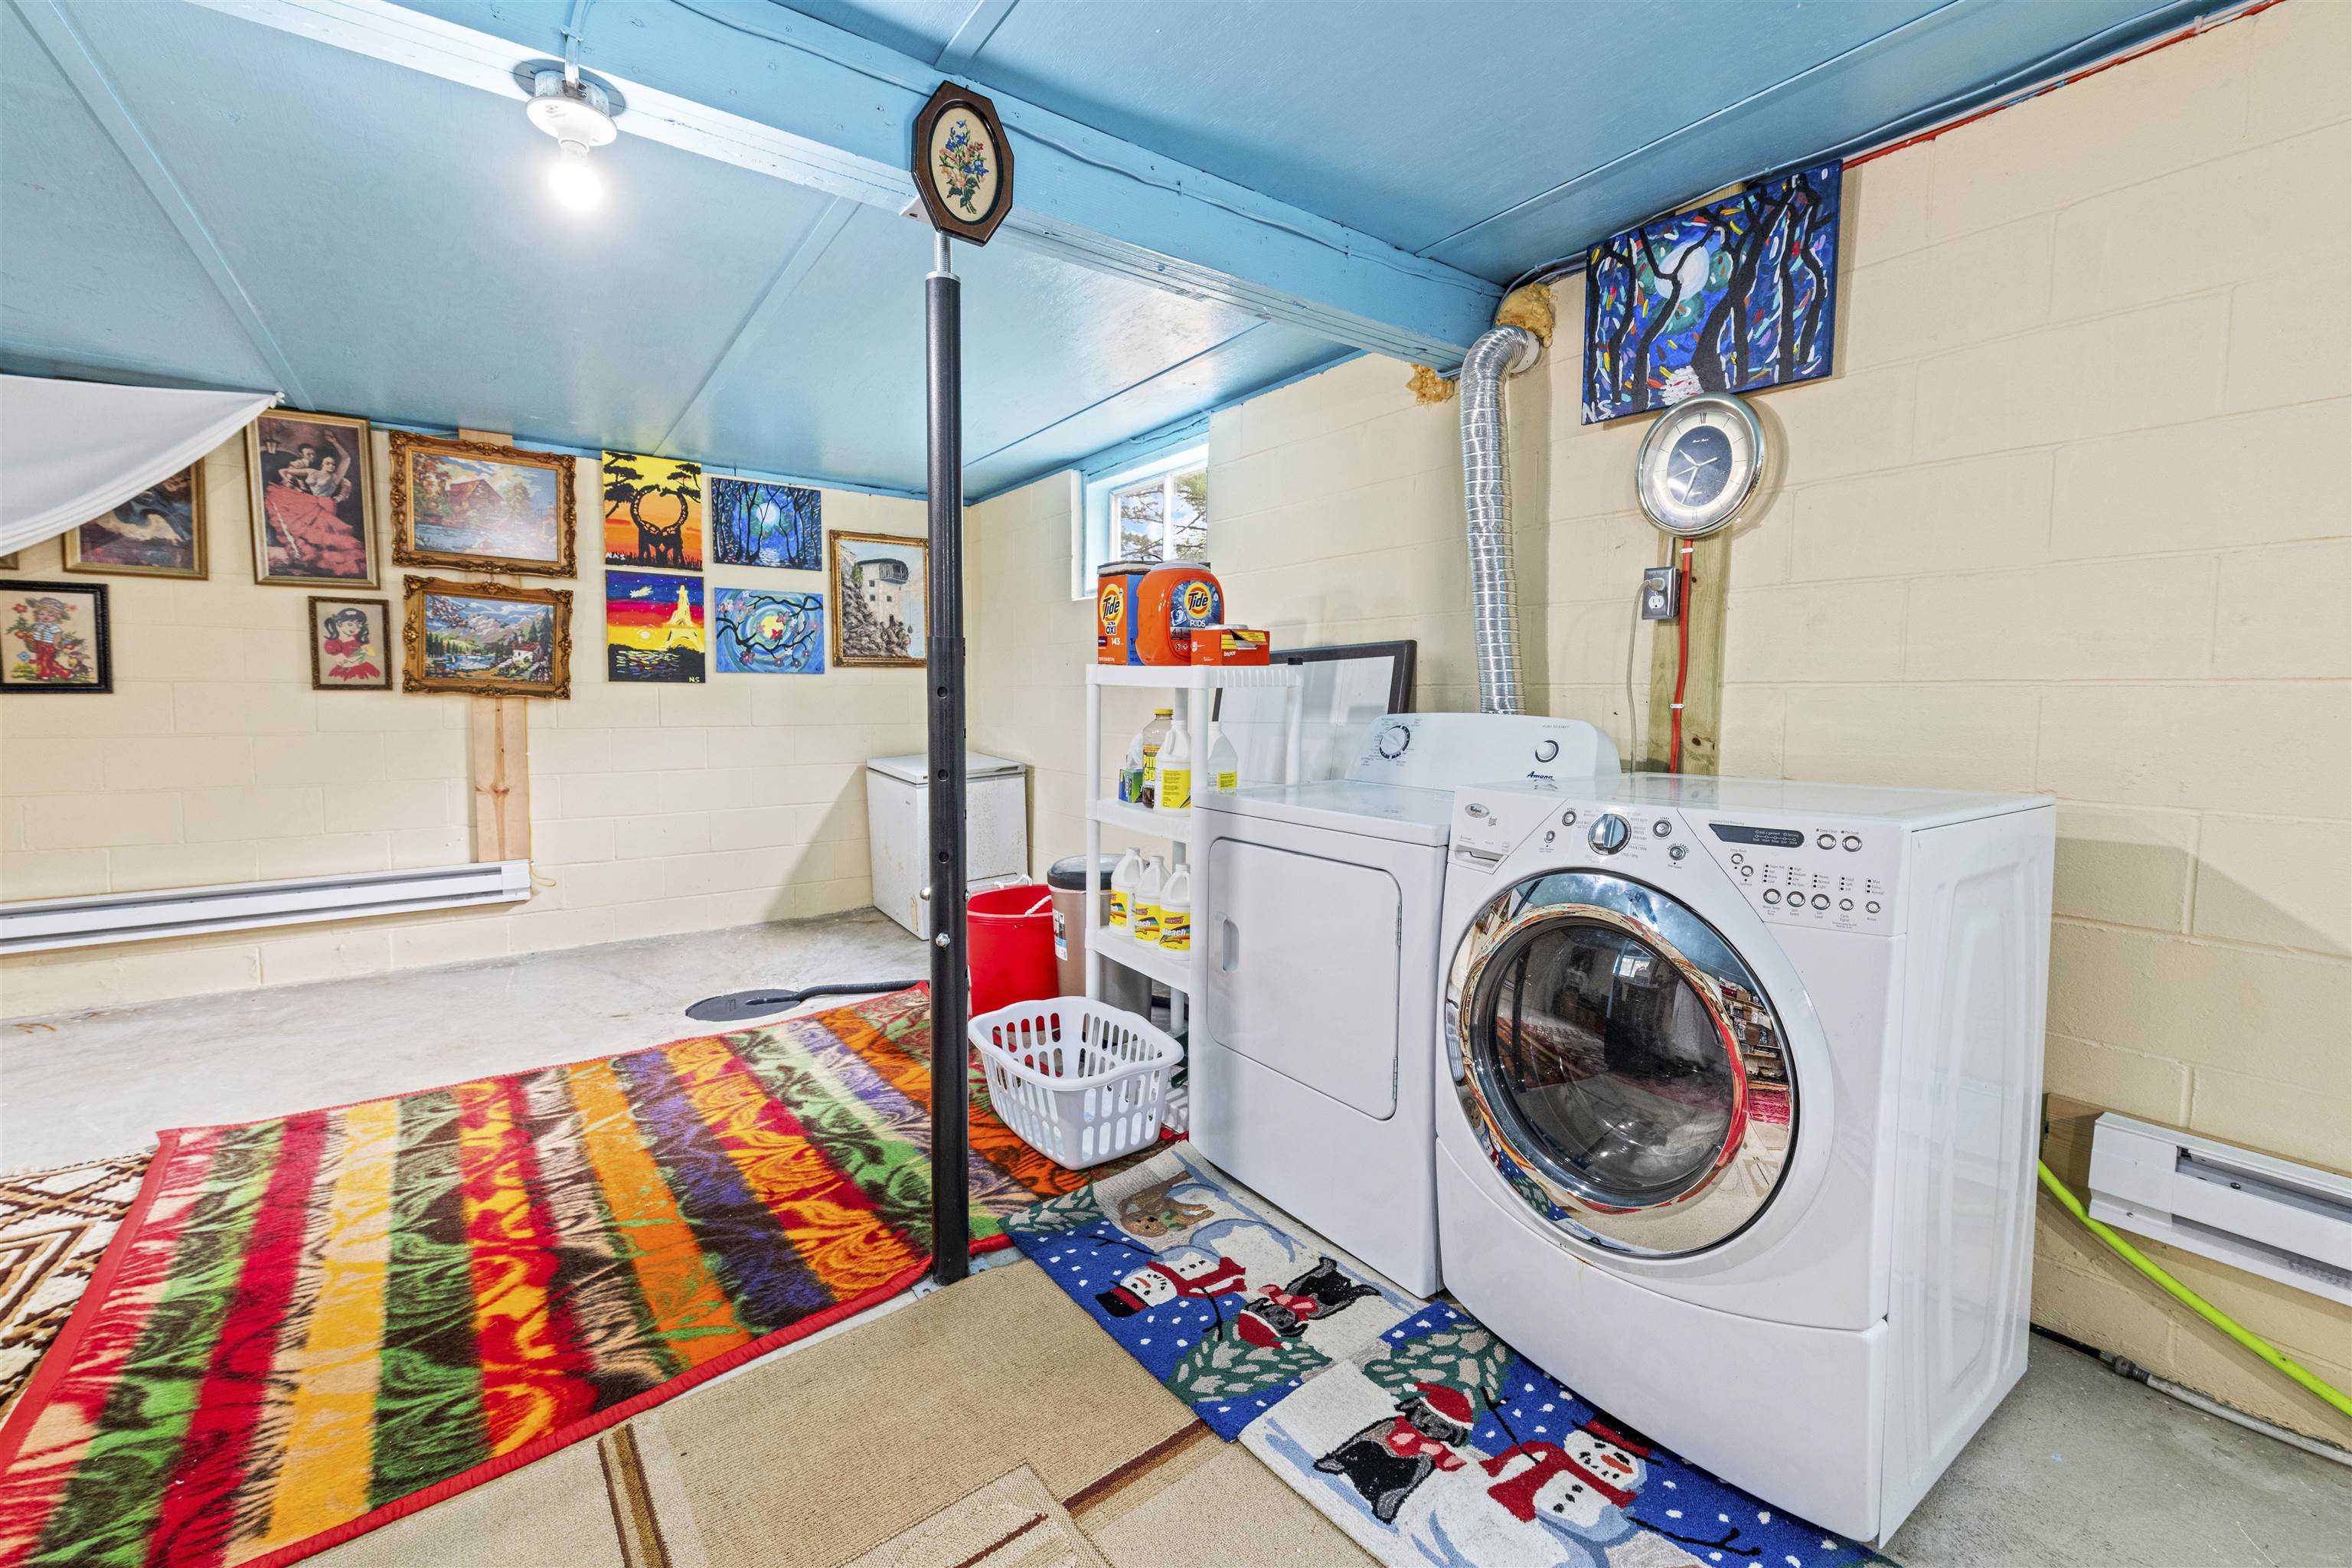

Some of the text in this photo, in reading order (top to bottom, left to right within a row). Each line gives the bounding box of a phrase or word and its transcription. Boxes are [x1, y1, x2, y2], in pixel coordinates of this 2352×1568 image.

[1188, 591, 1208, 610] Tide
[1102, 596, 1120, 620] Tide
[1106, 626, 1116, 634] OXI
[1143, 755, 1155, 768] Pin
[1144, 768, 1155, 781] So
[1526, 771, 1553, 779] Amana
[1161, 927, 1187, 936] Bleach
